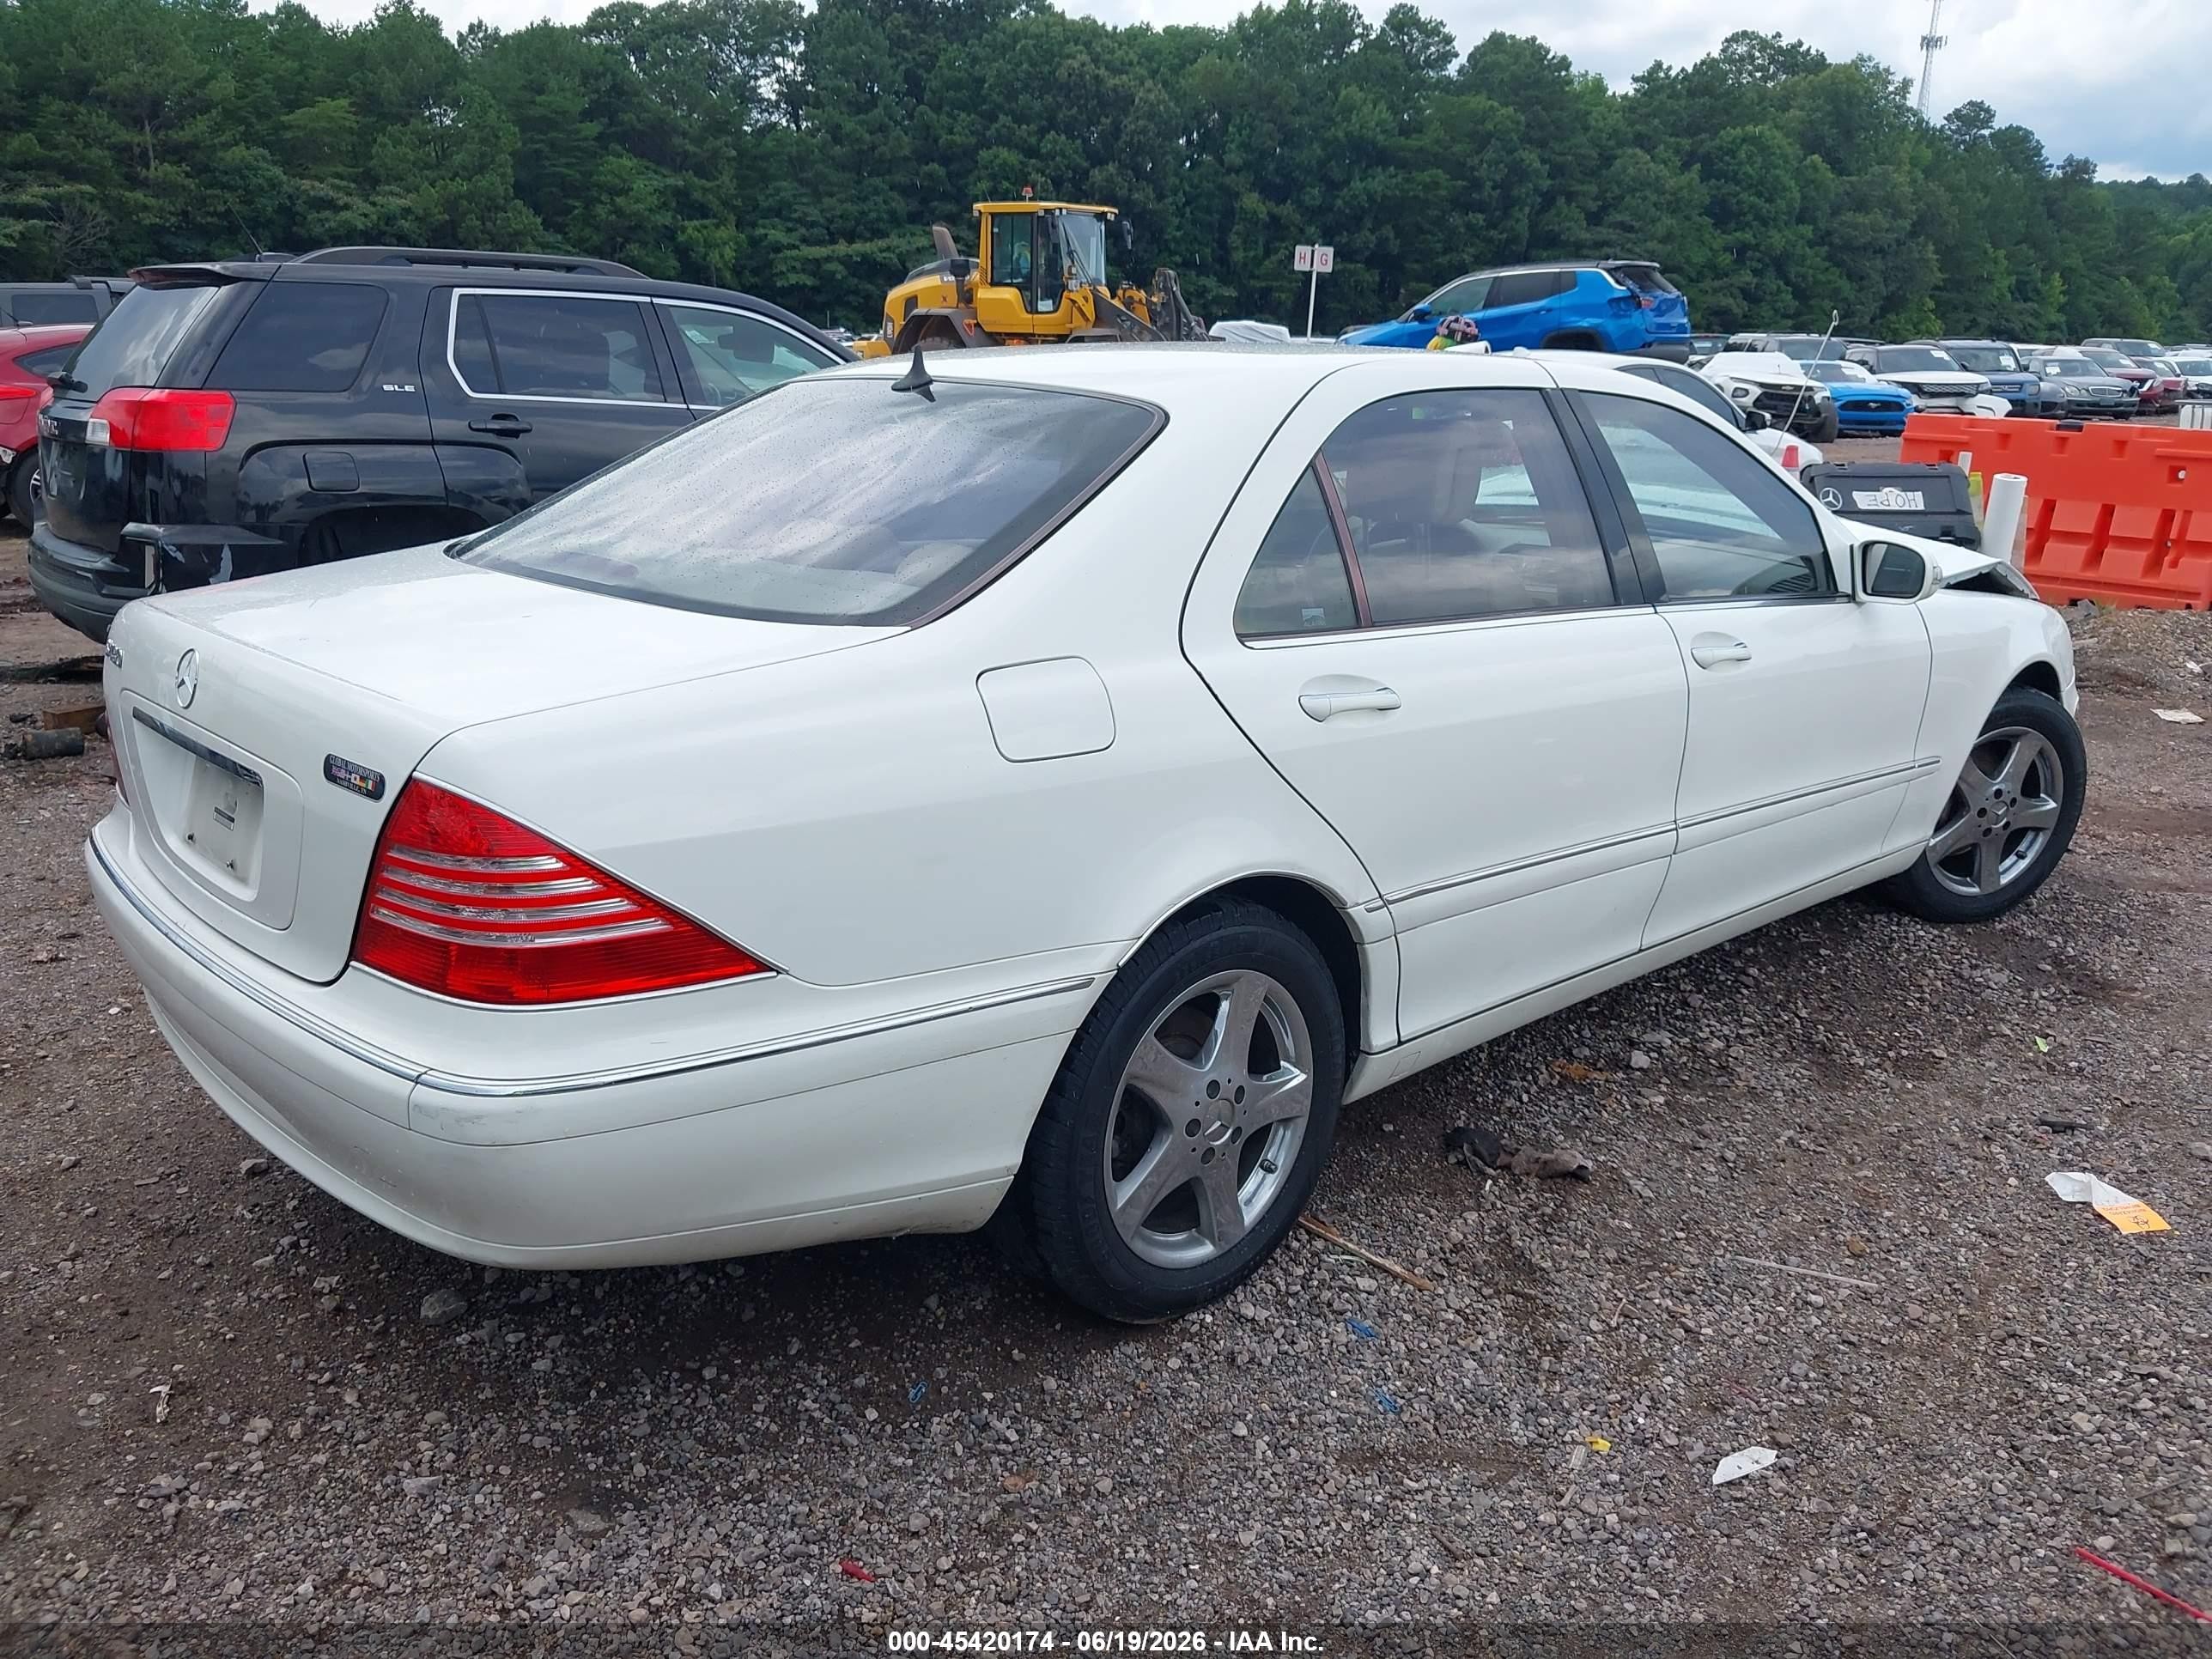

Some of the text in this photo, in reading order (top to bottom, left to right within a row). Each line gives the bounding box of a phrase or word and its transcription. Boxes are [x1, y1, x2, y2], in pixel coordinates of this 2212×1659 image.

[1298, 252, 1306, 264] H
[1320, 253, 1328, 266] G
[382, 384, 416, 392] SLE
[1866, 492, 1918, 509] HOPE
[330, 755, 348, 771] GLOBAL
